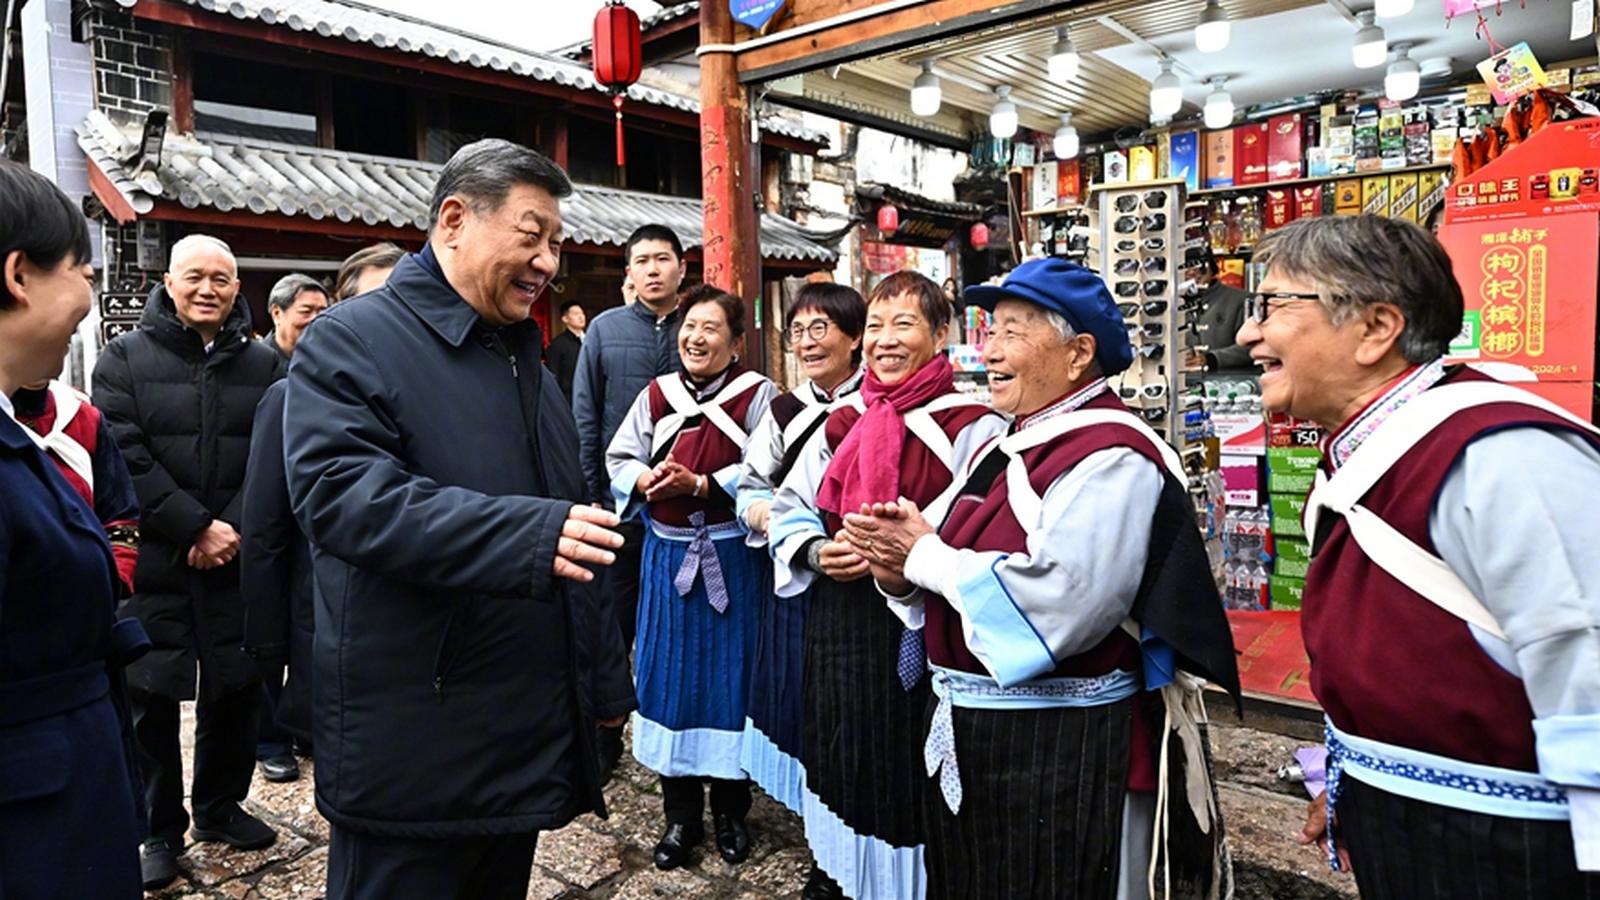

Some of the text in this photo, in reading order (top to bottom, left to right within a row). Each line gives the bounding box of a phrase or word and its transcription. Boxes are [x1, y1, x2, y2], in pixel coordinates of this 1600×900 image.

[1457, 178, 1519, 196] 口味王
[1485, 252, 1520, 353] 枸杞槟榔
